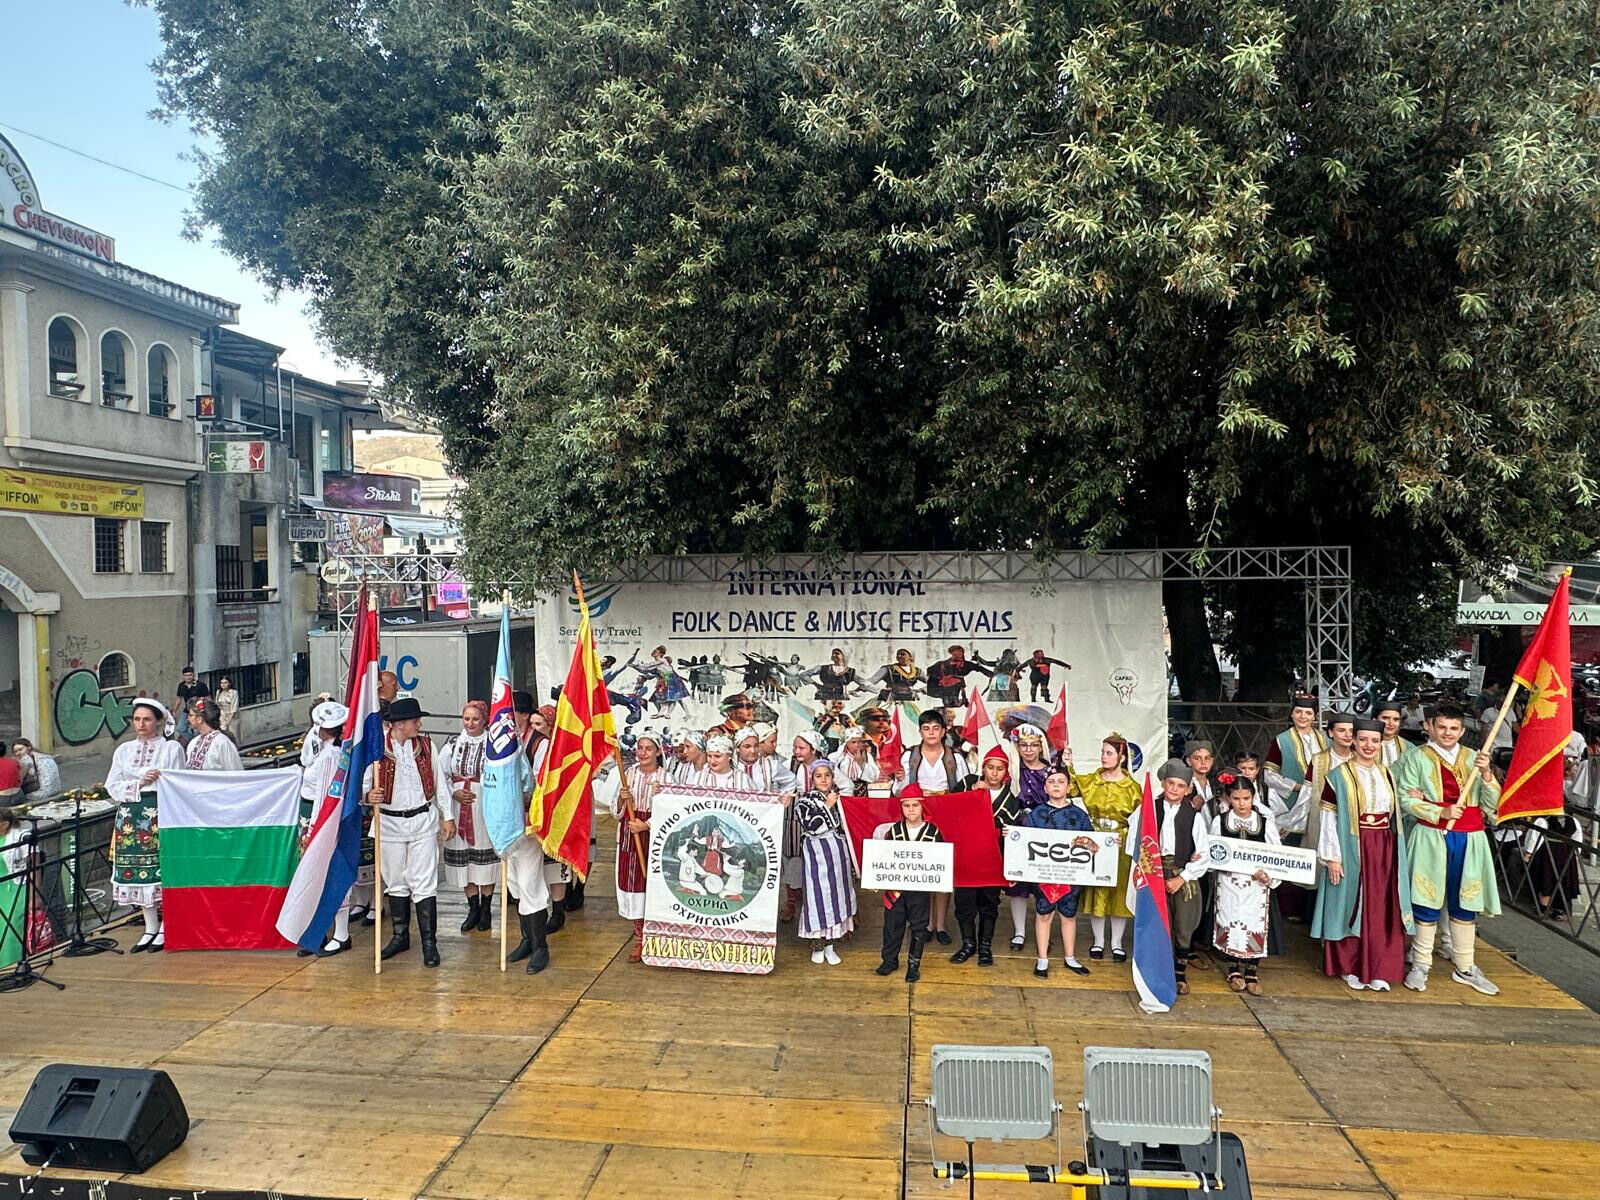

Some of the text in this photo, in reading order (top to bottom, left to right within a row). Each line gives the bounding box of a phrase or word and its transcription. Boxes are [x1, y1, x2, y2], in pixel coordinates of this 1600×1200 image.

[13, 204, 112, 261] CHEVIGNON
[291, 529, 325, 539] ШЕРКО
[334, 521, 351, 533] FIFA
[358, 524, 378, 542] 2026
[727, 569, 926, 597] INTERNATIONAL
[672, 609, 1013, 633] FOLK DANCE & MUSIC FESTIVALS
[607, 626, 642, 637] Travel
[651, 813, 680, 874] КУЛТУРНО
[757, 827, 778, 890] ДРУШТВО
[893, 851, 923, 860] NEFES
[1027, 841, 1091, 864] FES
[1233, 851, 1312, 871] ЕЛЕКТРОПОРЦЕЛАН
[872, 862, 945, 872] HALK OYUNLARI
[876, 874, 941, 884] SPOR KULÜBÜ
[642, 935, 775, 967] МАКЕДОНИЈА
